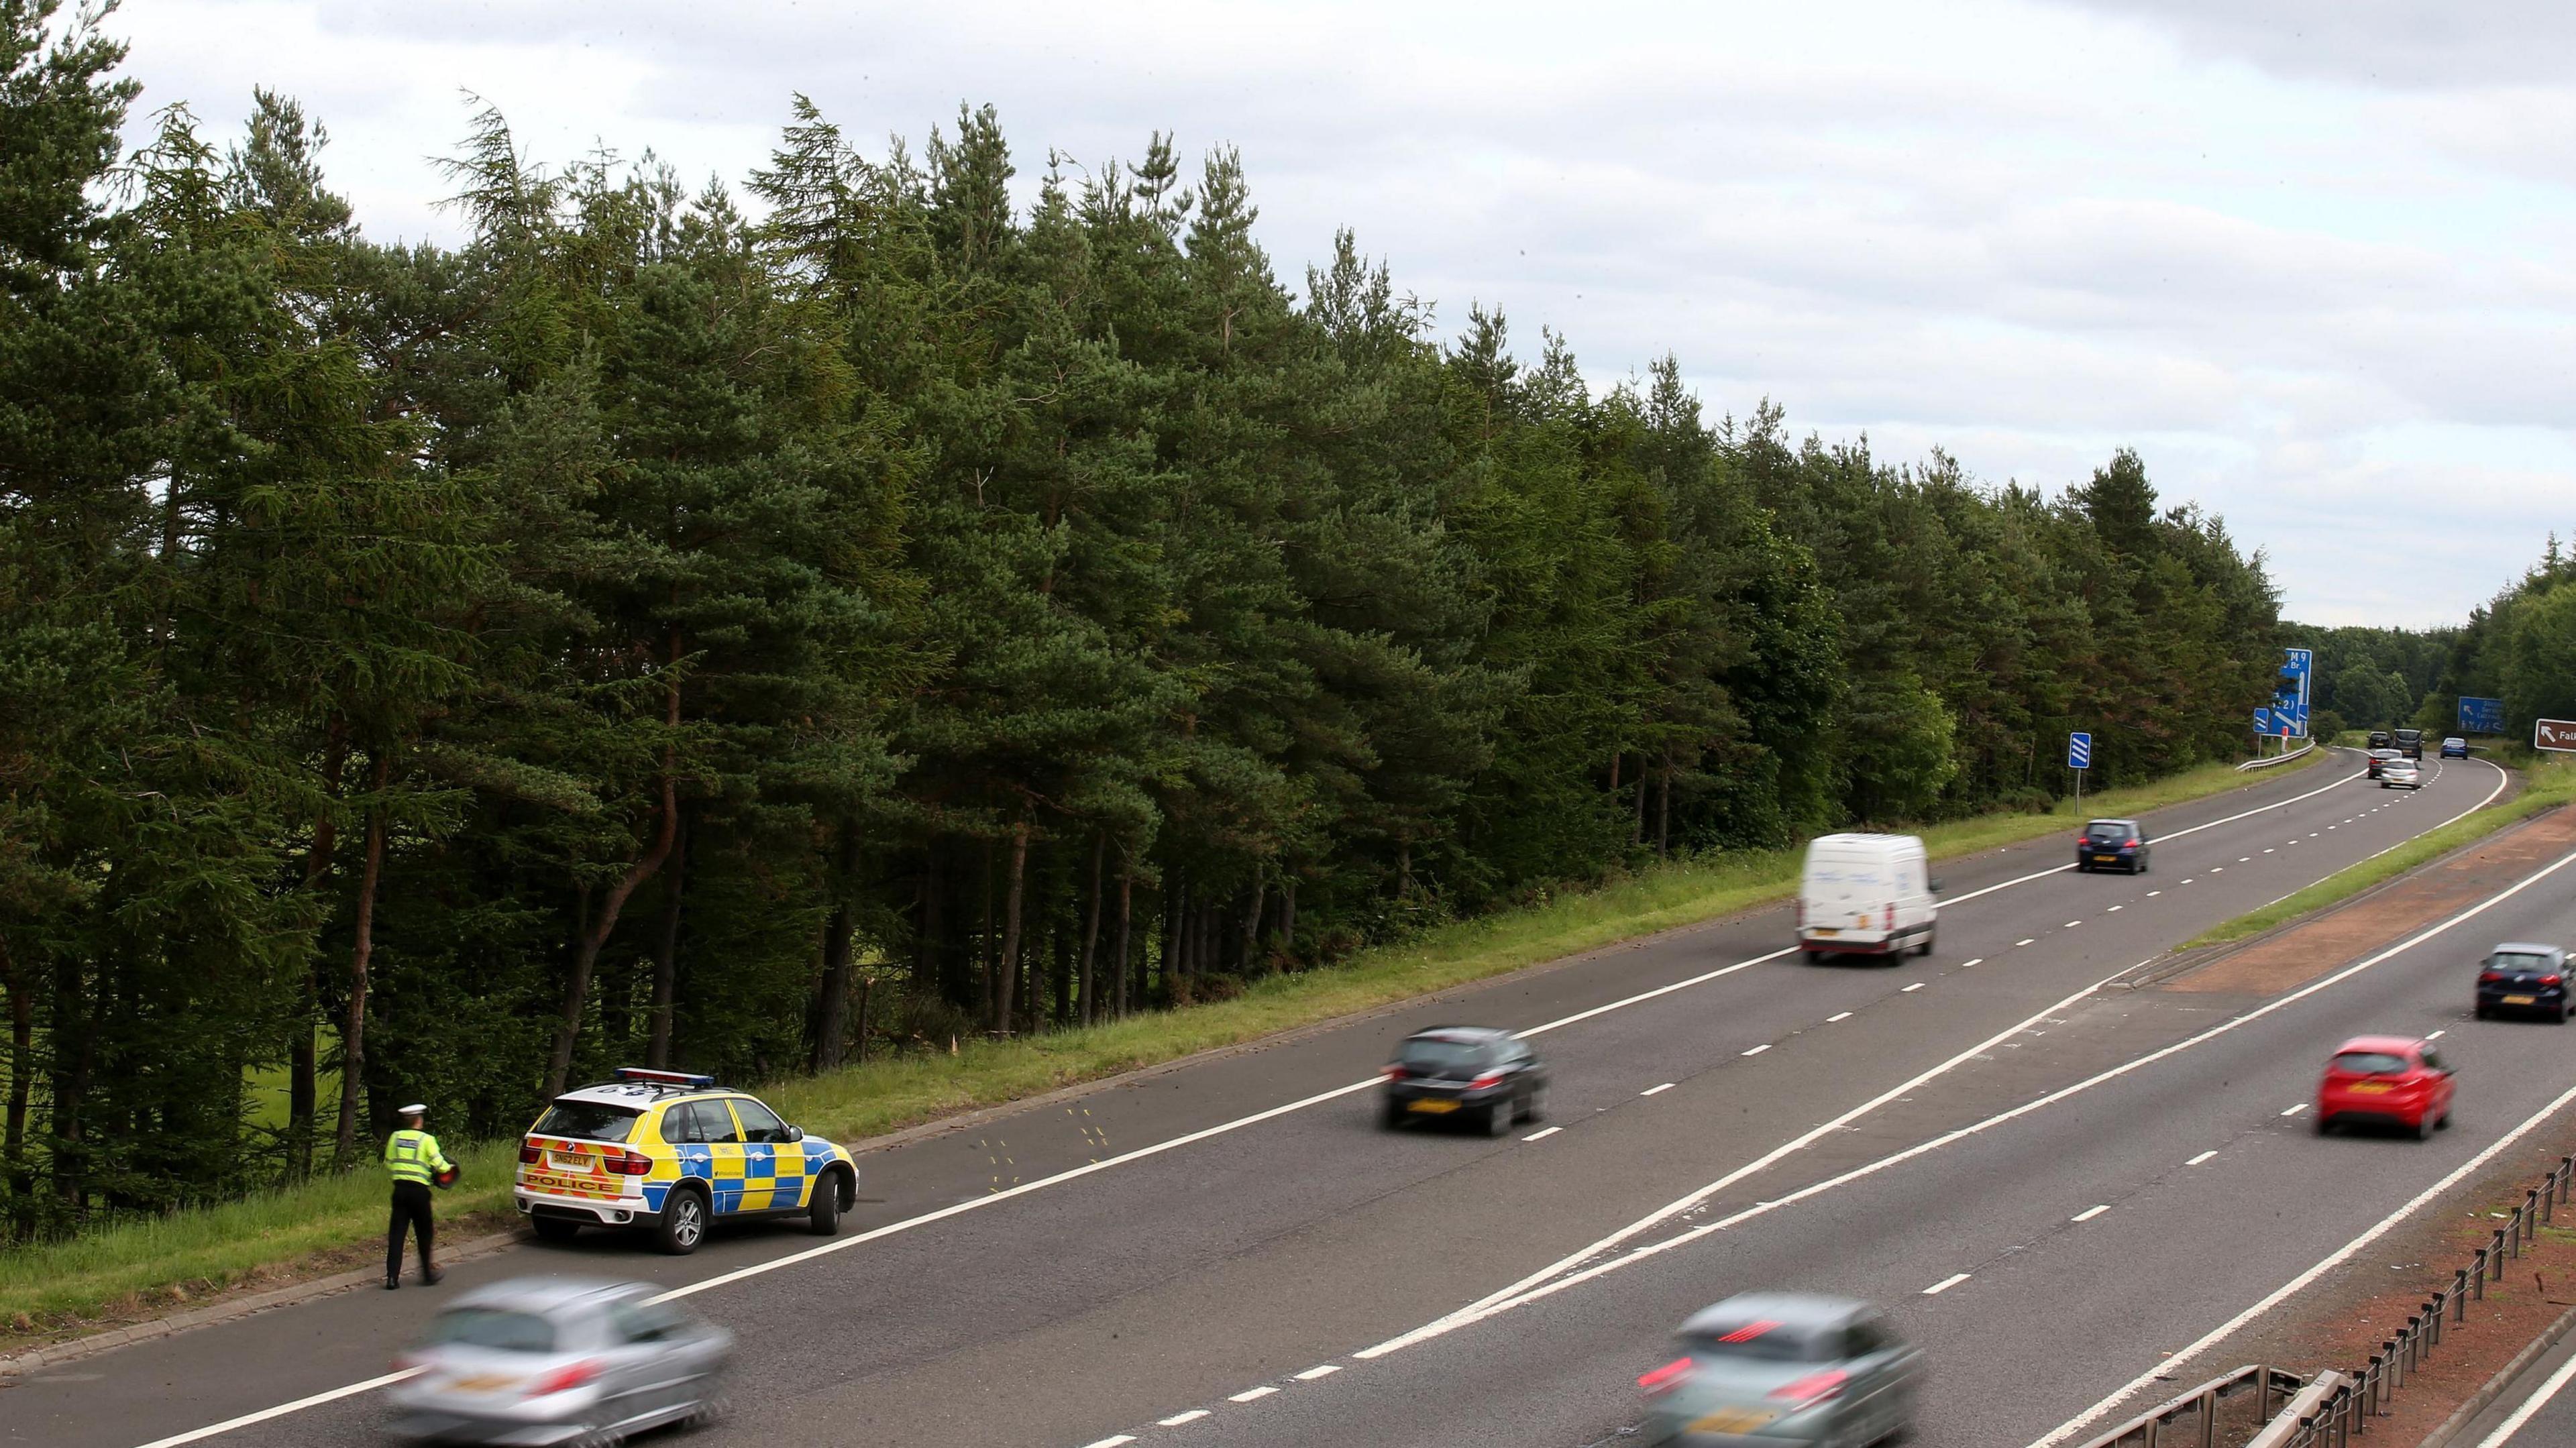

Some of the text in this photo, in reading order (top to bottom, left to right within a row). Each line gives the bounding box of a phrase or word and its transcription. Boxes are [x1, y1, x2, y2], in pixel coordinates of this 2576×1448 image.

[554, 1154, 589, 1165] SN62 ELV
[527, 1175, 614, 1192] POLICE
